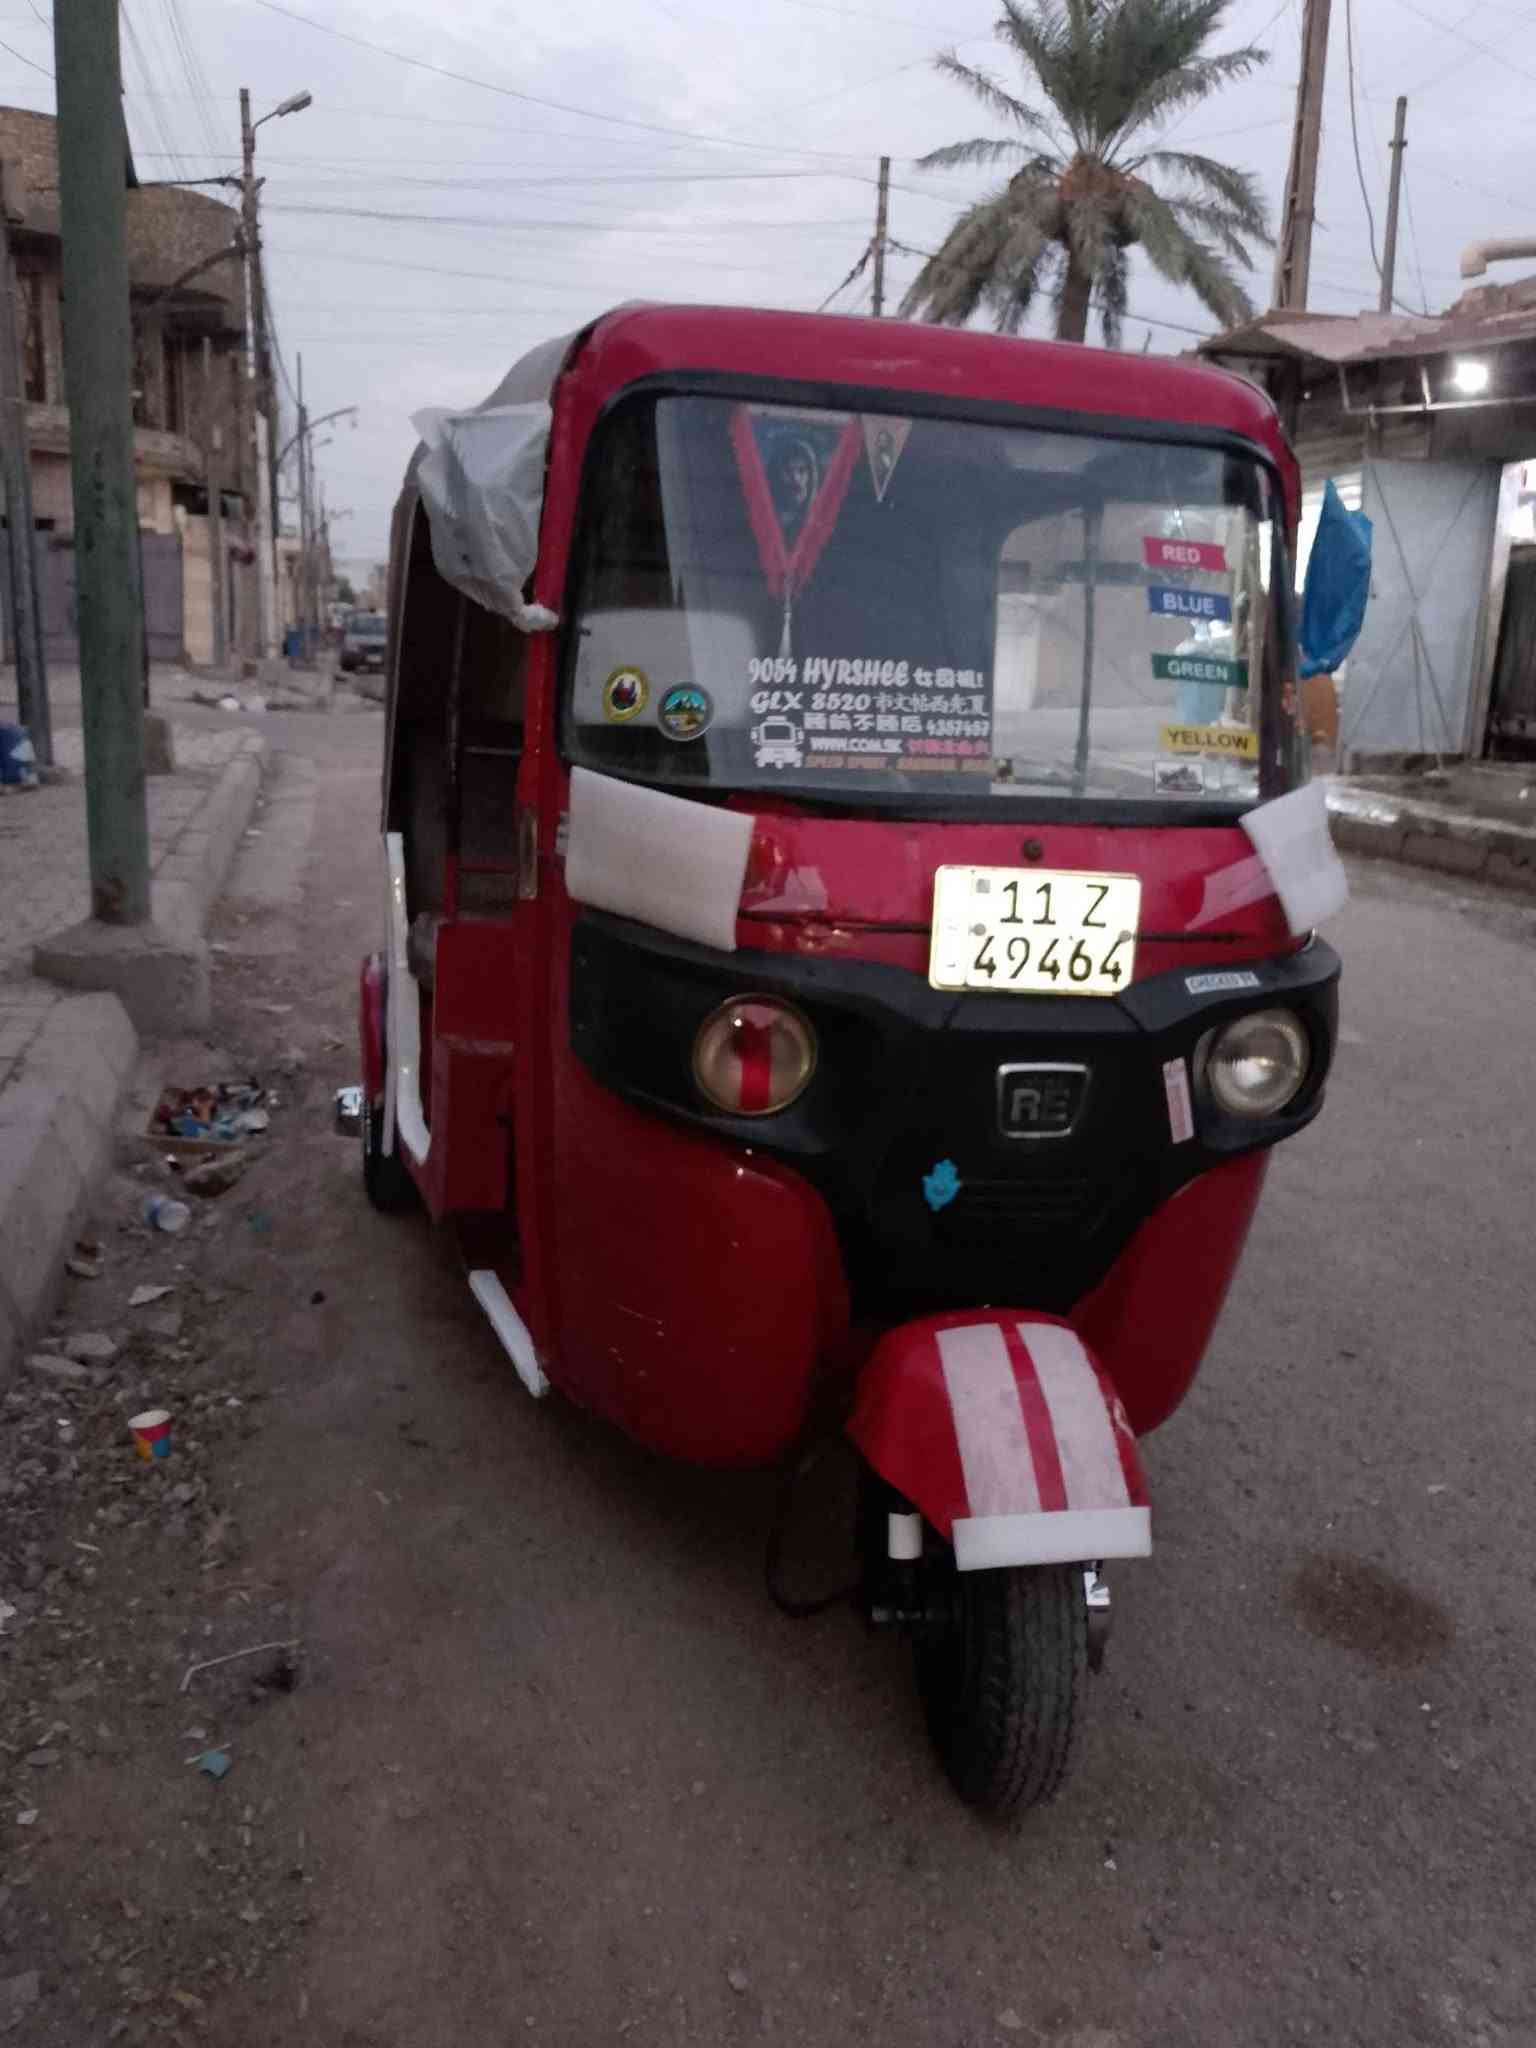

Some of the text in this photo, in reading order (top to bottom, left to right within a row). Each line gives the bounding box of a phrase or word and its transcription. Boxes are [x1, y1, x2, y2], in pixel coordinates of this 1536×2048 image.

[1161, 544, 1201, 565] RED
[1162, 592, 1216, 616] BLUE
[1166, 660, 1229, 681] GREEN
[1167, 729, 1249, 751] YELLOW
[1000, 881, 1109, 928] 11 Z
[974, 936, 1122, 983] 49464
[1011, 1087, 1071, 1122] RE
